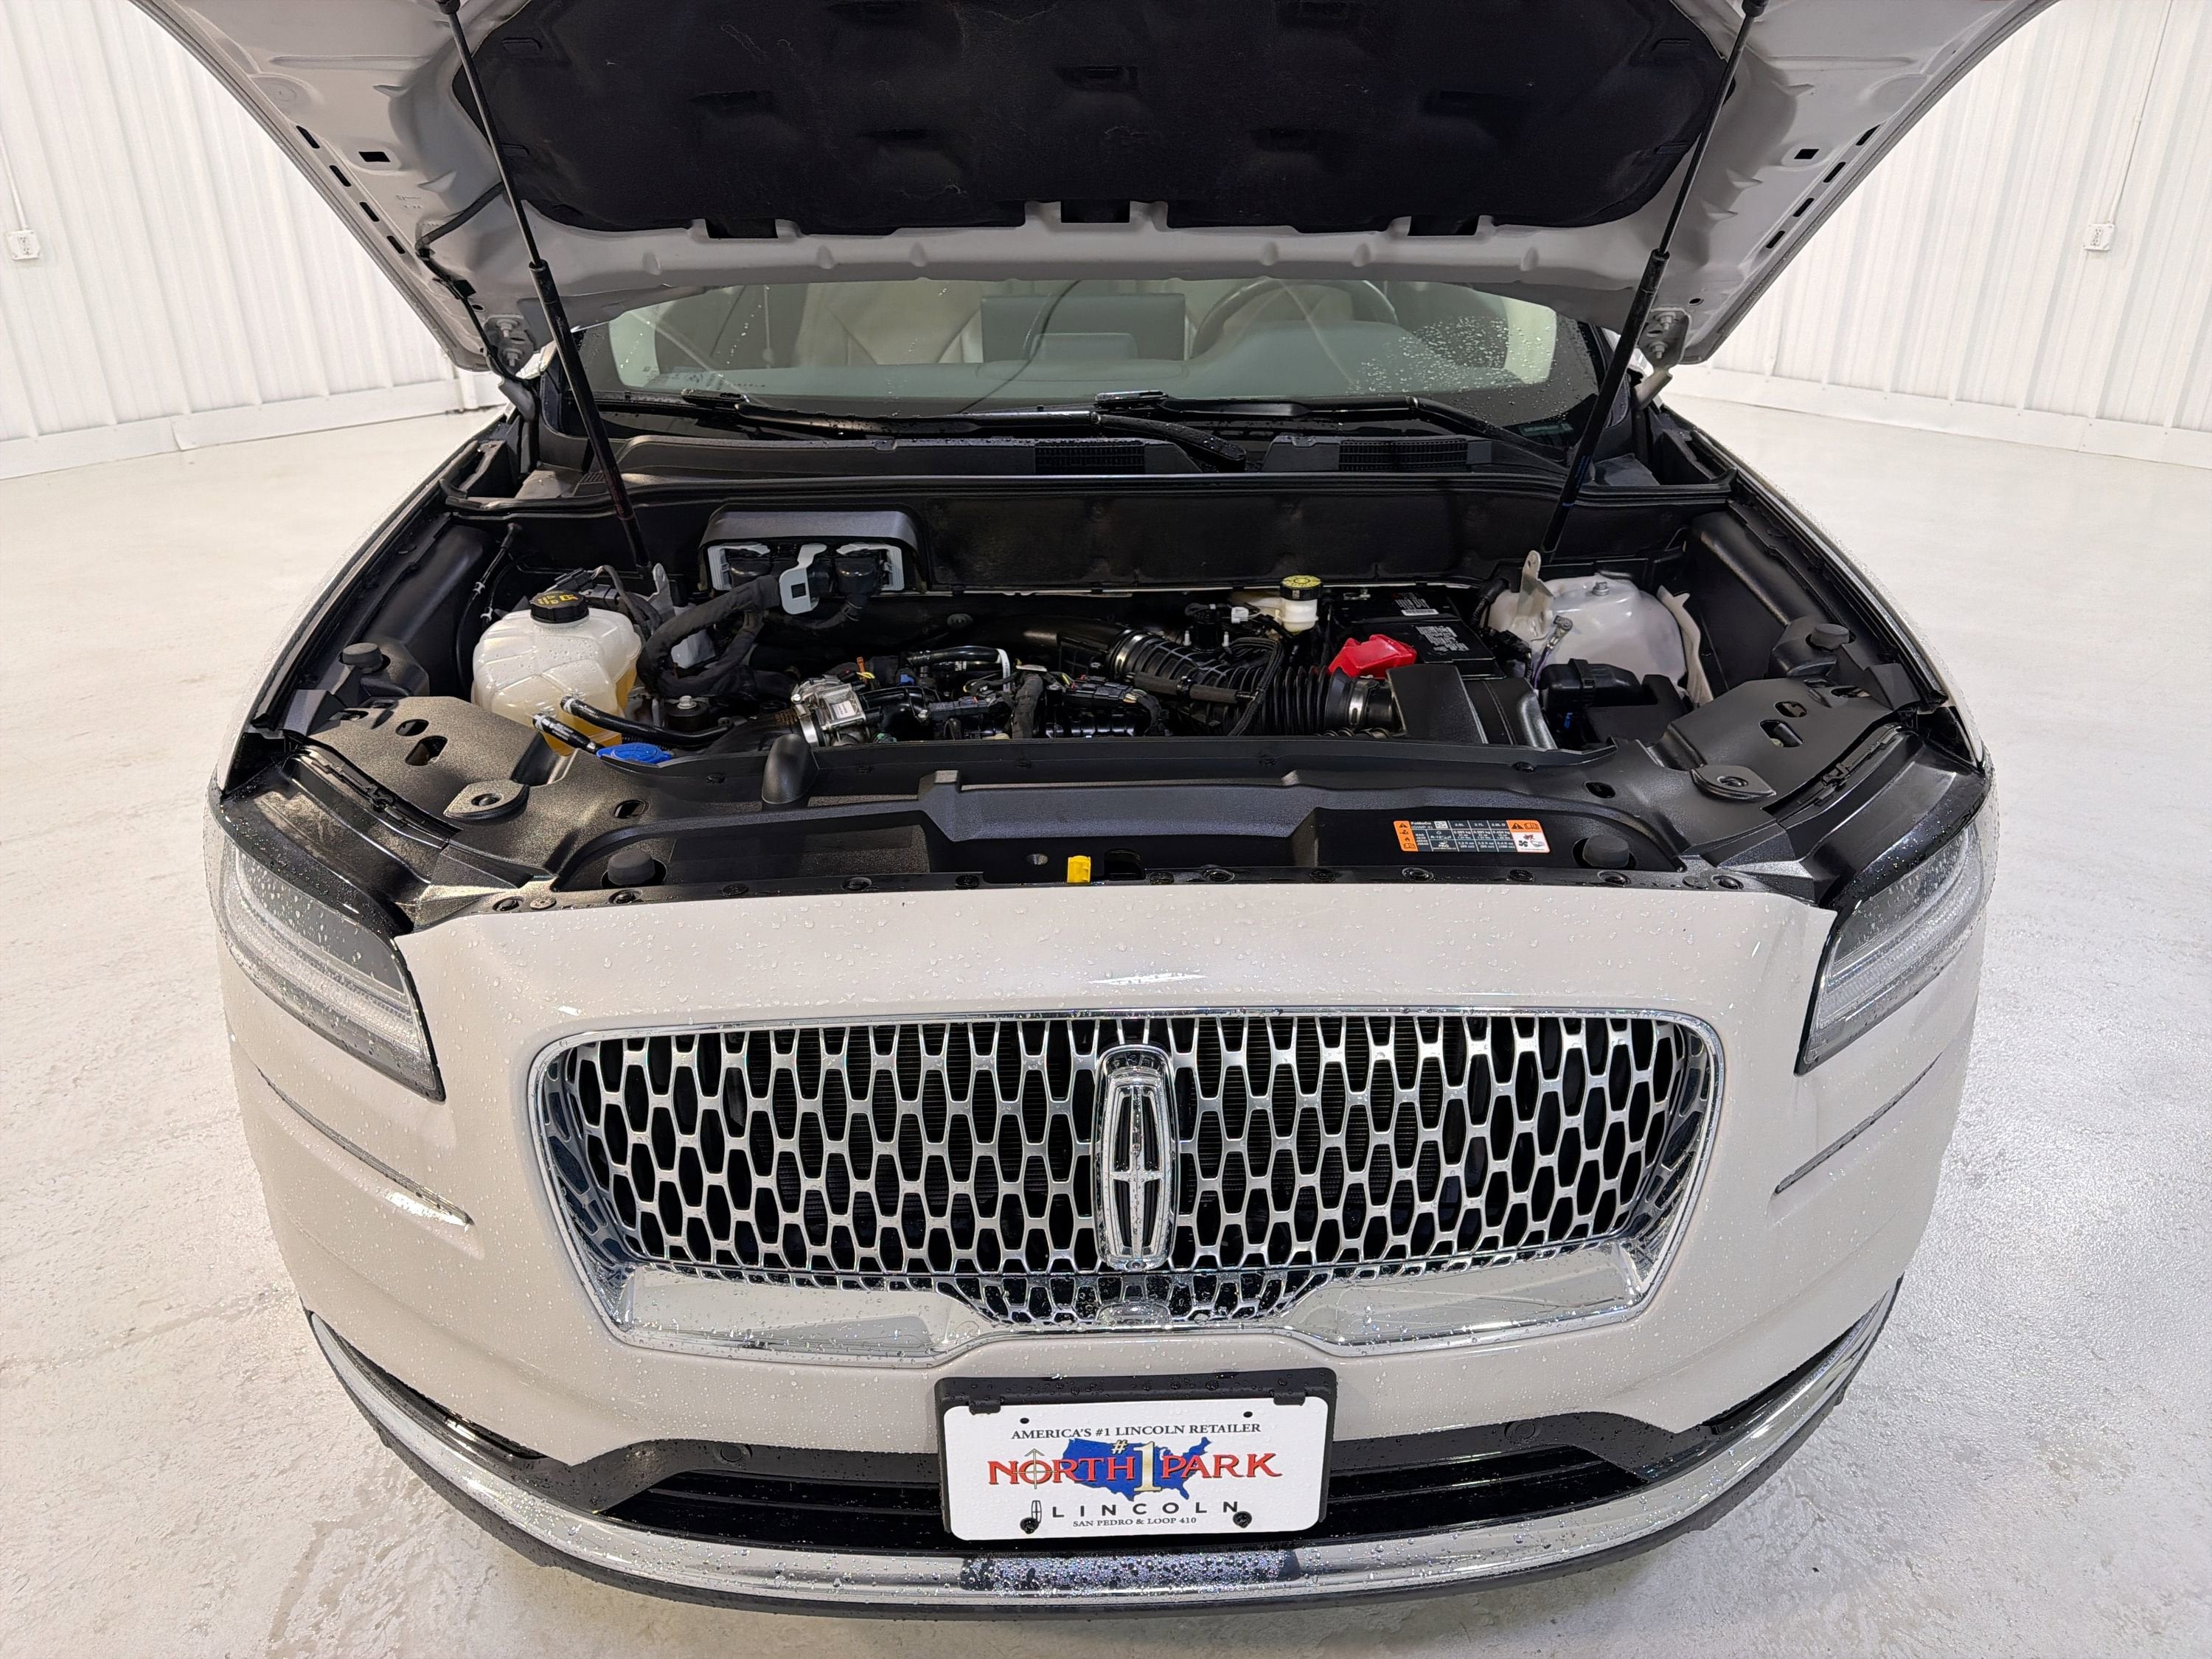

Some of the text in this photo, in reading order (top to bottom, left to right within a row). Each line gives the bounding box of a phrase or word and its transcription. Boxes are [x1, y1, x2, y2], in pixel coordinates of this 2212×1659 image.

[1011, 1424, 1262, 1439] AMERICA'S #1 LINCOLN RETAILER
[987, 1453, 1283, 1485] NORTH PARK
[1052, 1501, 1238, 1518] LINCOLN
